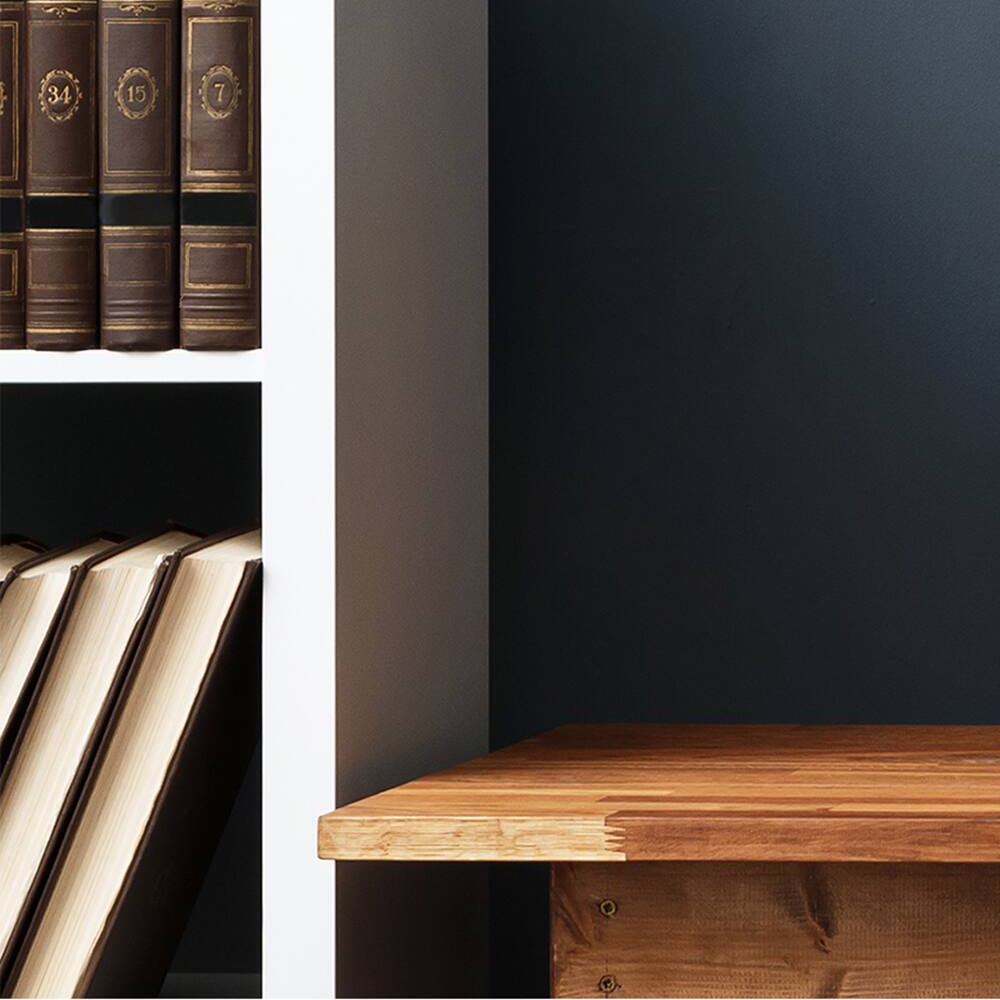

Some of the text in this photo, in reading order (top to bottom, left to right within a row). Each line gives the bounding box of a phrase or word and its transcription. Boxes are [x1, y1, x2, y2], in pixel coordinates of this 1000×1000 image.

[48, 84, 72, 104] 34
[127, 84, 146, 102] 15
[214, 83, 225, 102] 7
